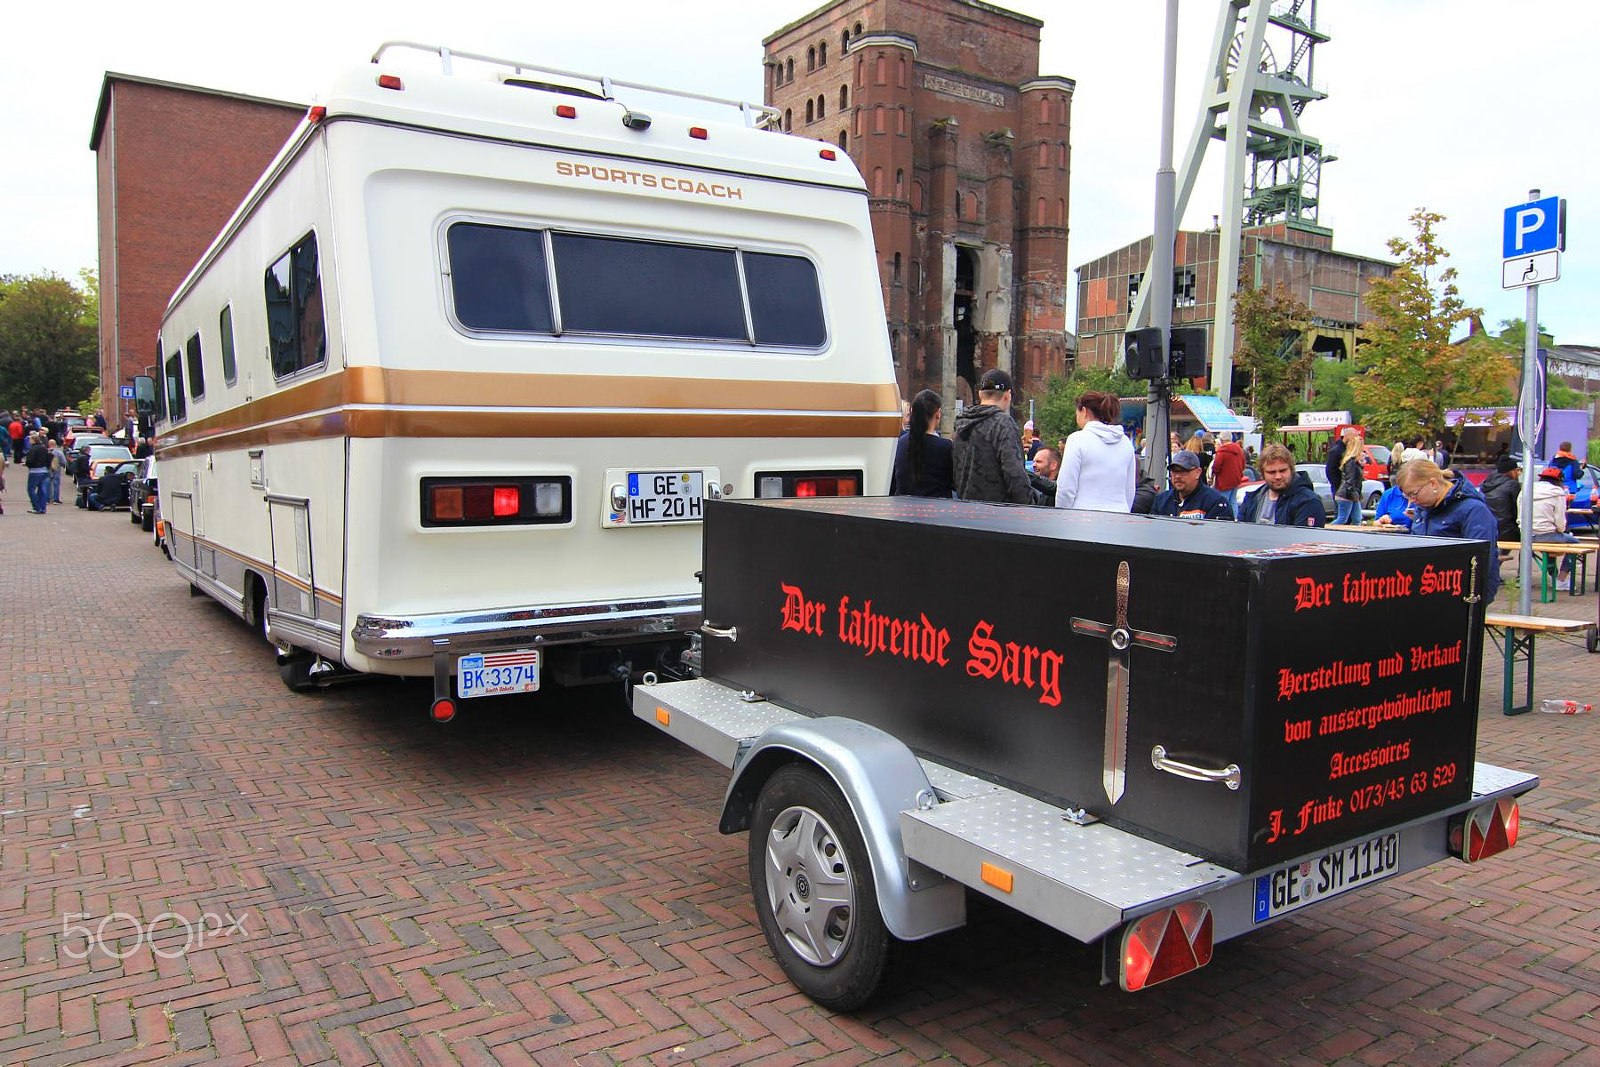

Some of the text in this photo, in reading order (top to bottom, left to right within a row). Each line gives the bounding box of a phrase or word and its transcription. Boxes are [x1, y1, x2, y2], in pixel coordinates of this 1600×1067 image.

[1515, 207, 1545, 251] P
[631, 496, 701, 519] HF 20 H
[653, 476, 678, 496] GE
[1294, 564, 1463, 613] Der fahrende Sarg
[781, 581, 1064, 707] Der fahrende Sarg
[1277, 640, 1462, 702] Herstellung und Verkauf
[1284, 686, 1452, 744] von aussergewöhnlichen
[1294, 795, 1344, 836] Finke
[1350, 776, 1405, 808] 0173/45
[1410, 771, 1428, 794] 63
[1432, 762, 1456, 789] 829
[1271, 865, 1300, 910] GE
[1317, 850, 1345, 894] SM
[1348, 833, 1397, 883] 1110
